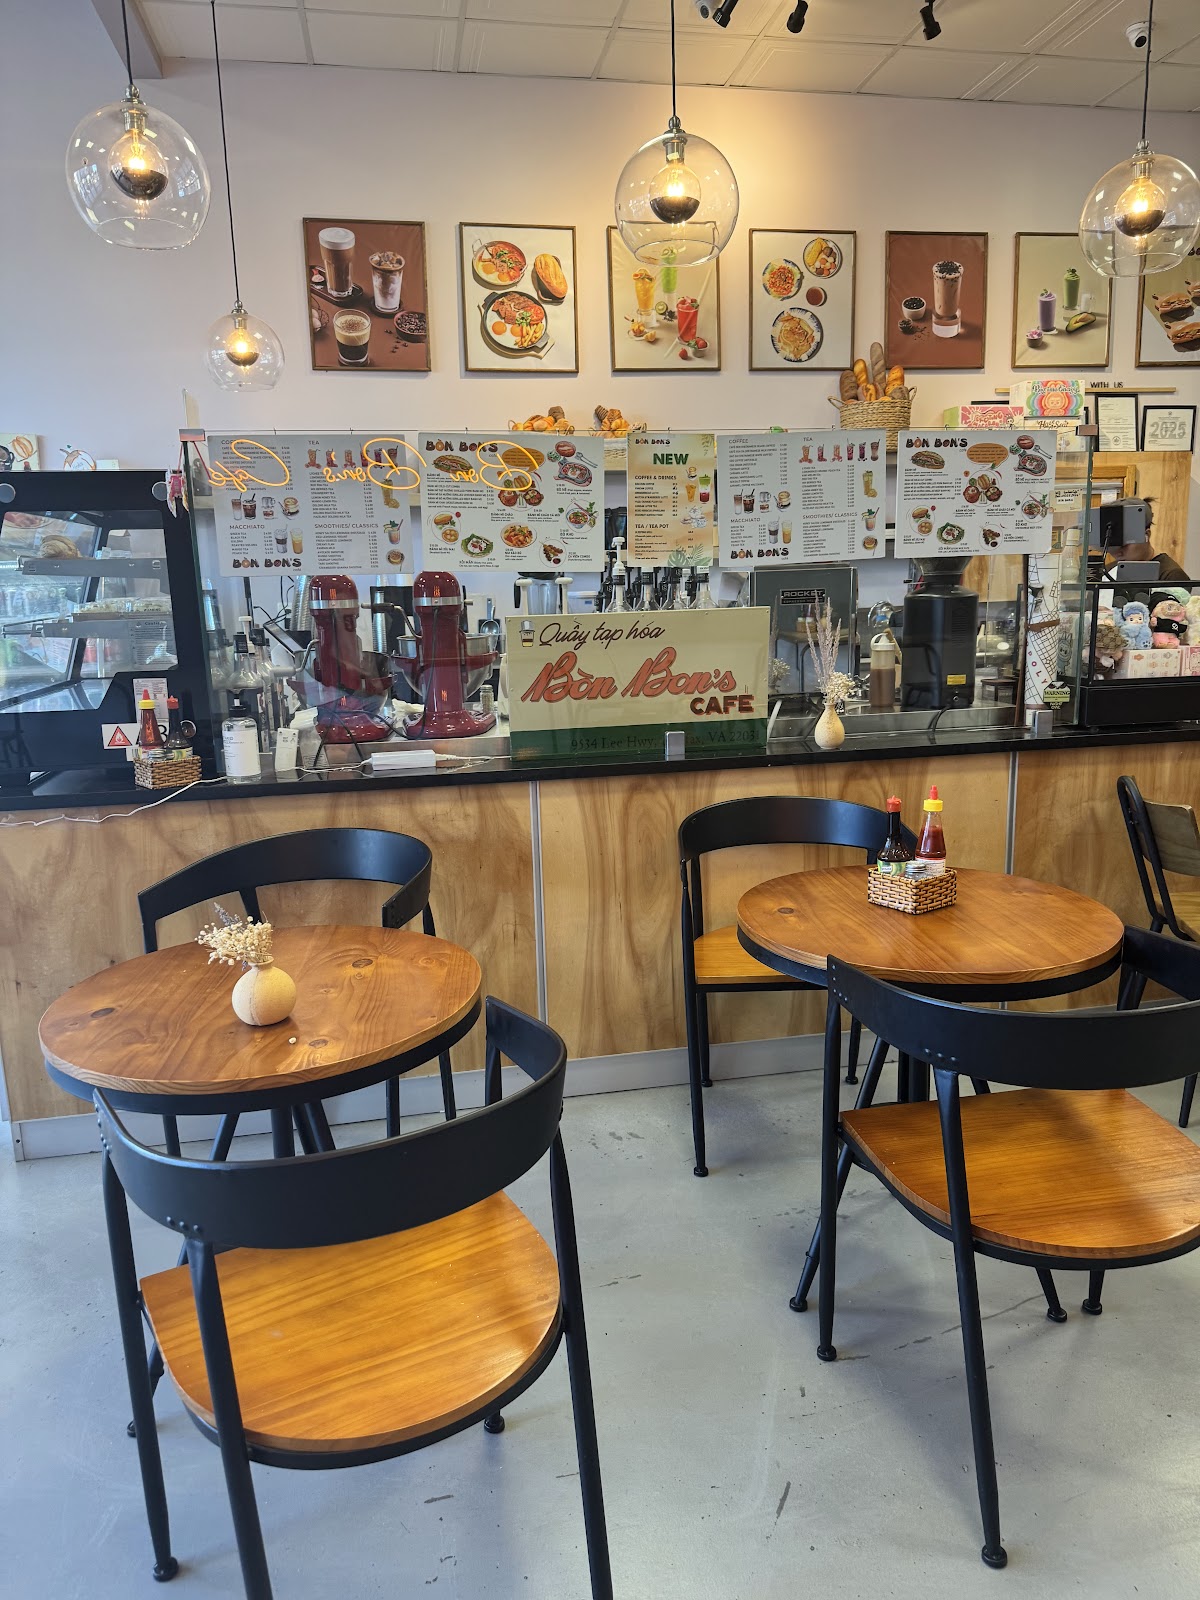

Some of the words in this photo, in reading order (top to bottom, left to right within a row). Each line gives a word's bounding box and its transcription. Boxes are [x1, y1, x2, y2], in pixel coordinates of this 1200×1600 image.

[1150, 421, 1186, 439] 2025
[425, 438, 454, 452] BÒN
[906, 436, 930, 448] BÒN
[934, 437, 968, 448] BON'S
[652, 453, 690, 465] NEW
[730, 548, 754, 560] BÒN
[757, 547, 790, 558] BON'S
[232, 556, 260, 569] BÒN
[264, 558, 302, 568] BON'S
[539, 620, 591, 650] Quầy
[592, 622, 624, 650] tạp
[626, 620, 666, 640] hóa
[521, 650, 618, 703] Bòn
[621, 646, 738, 698] Bon's
[570, 738, 598, 751] 9534
[601, 737, 623, 749] Lee
[626, 736, 657, 750] Hwy,
[708, 730, 726, 743] VA
